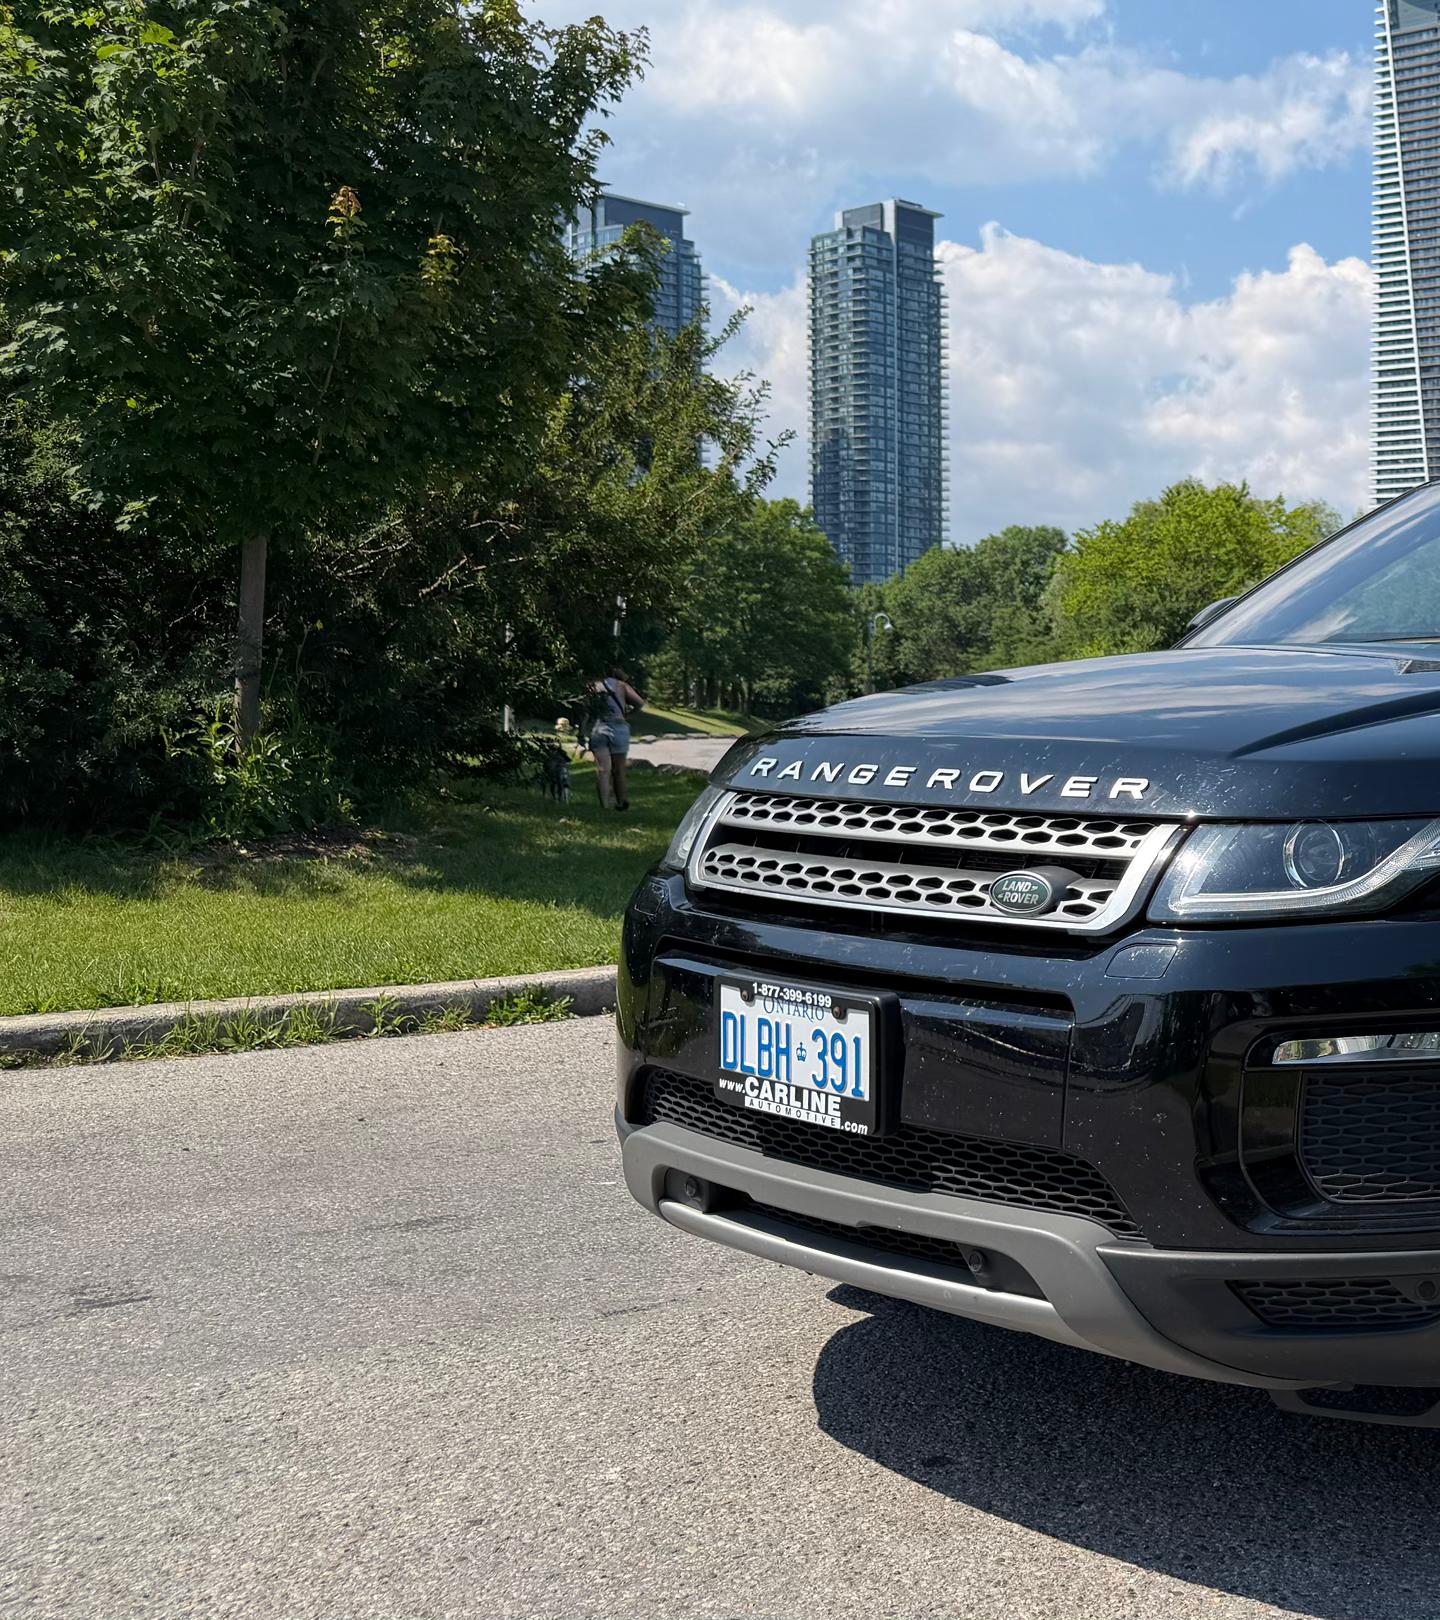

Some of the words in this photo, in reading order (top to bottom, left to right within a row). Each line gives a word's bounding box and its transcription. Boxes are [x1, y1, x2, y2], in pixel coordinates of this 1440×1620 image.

[750, 757, 918, 787] RANGE
[926, 768, 1150, 800] ROVER
[1002, 881, 1032, 893] LAND
[1003, 892, 1039, 904] ROVER
[752, 982, 832, 1008] 1-877-399-6199
[763, 996, 825, 1023] ONTARIO
[722, 1011, 792, 1083] DLBH
[811, 1028, 865, 1098] 391
[748, 1098, 837, 1127] AUTOMOTIVE
